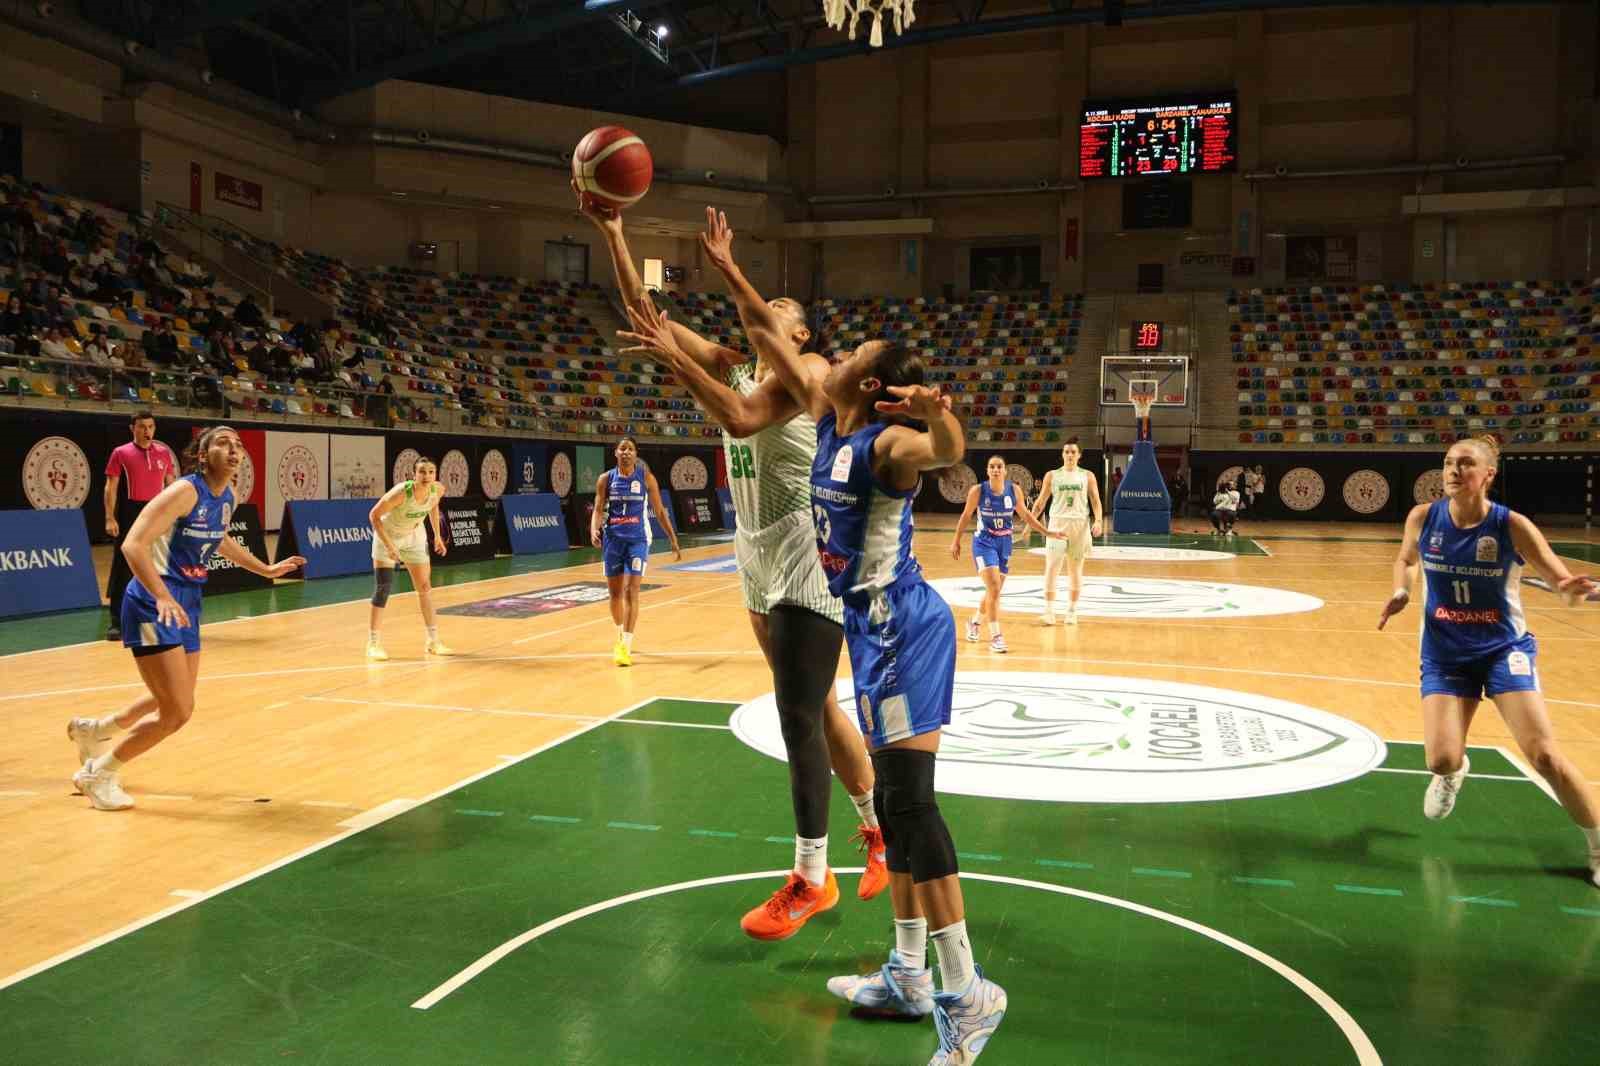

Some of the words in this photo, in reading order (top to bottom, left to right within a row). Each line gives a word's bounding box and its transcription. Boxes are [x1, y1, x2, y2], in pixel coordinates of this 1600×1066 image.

[1153, 148, 1161, 158] 2
[729, 444, 756, 480] 32
[622, 503, 627, 516] 1
[522, 515, 560, 528] HALKBANK
[322, 527, 374, 544] HALKBAN
[0, 547, 73, 571] KBANK
[1451, 579, 1472, 605] 11
[1434, 607, 1499, 625] DARDANEL
